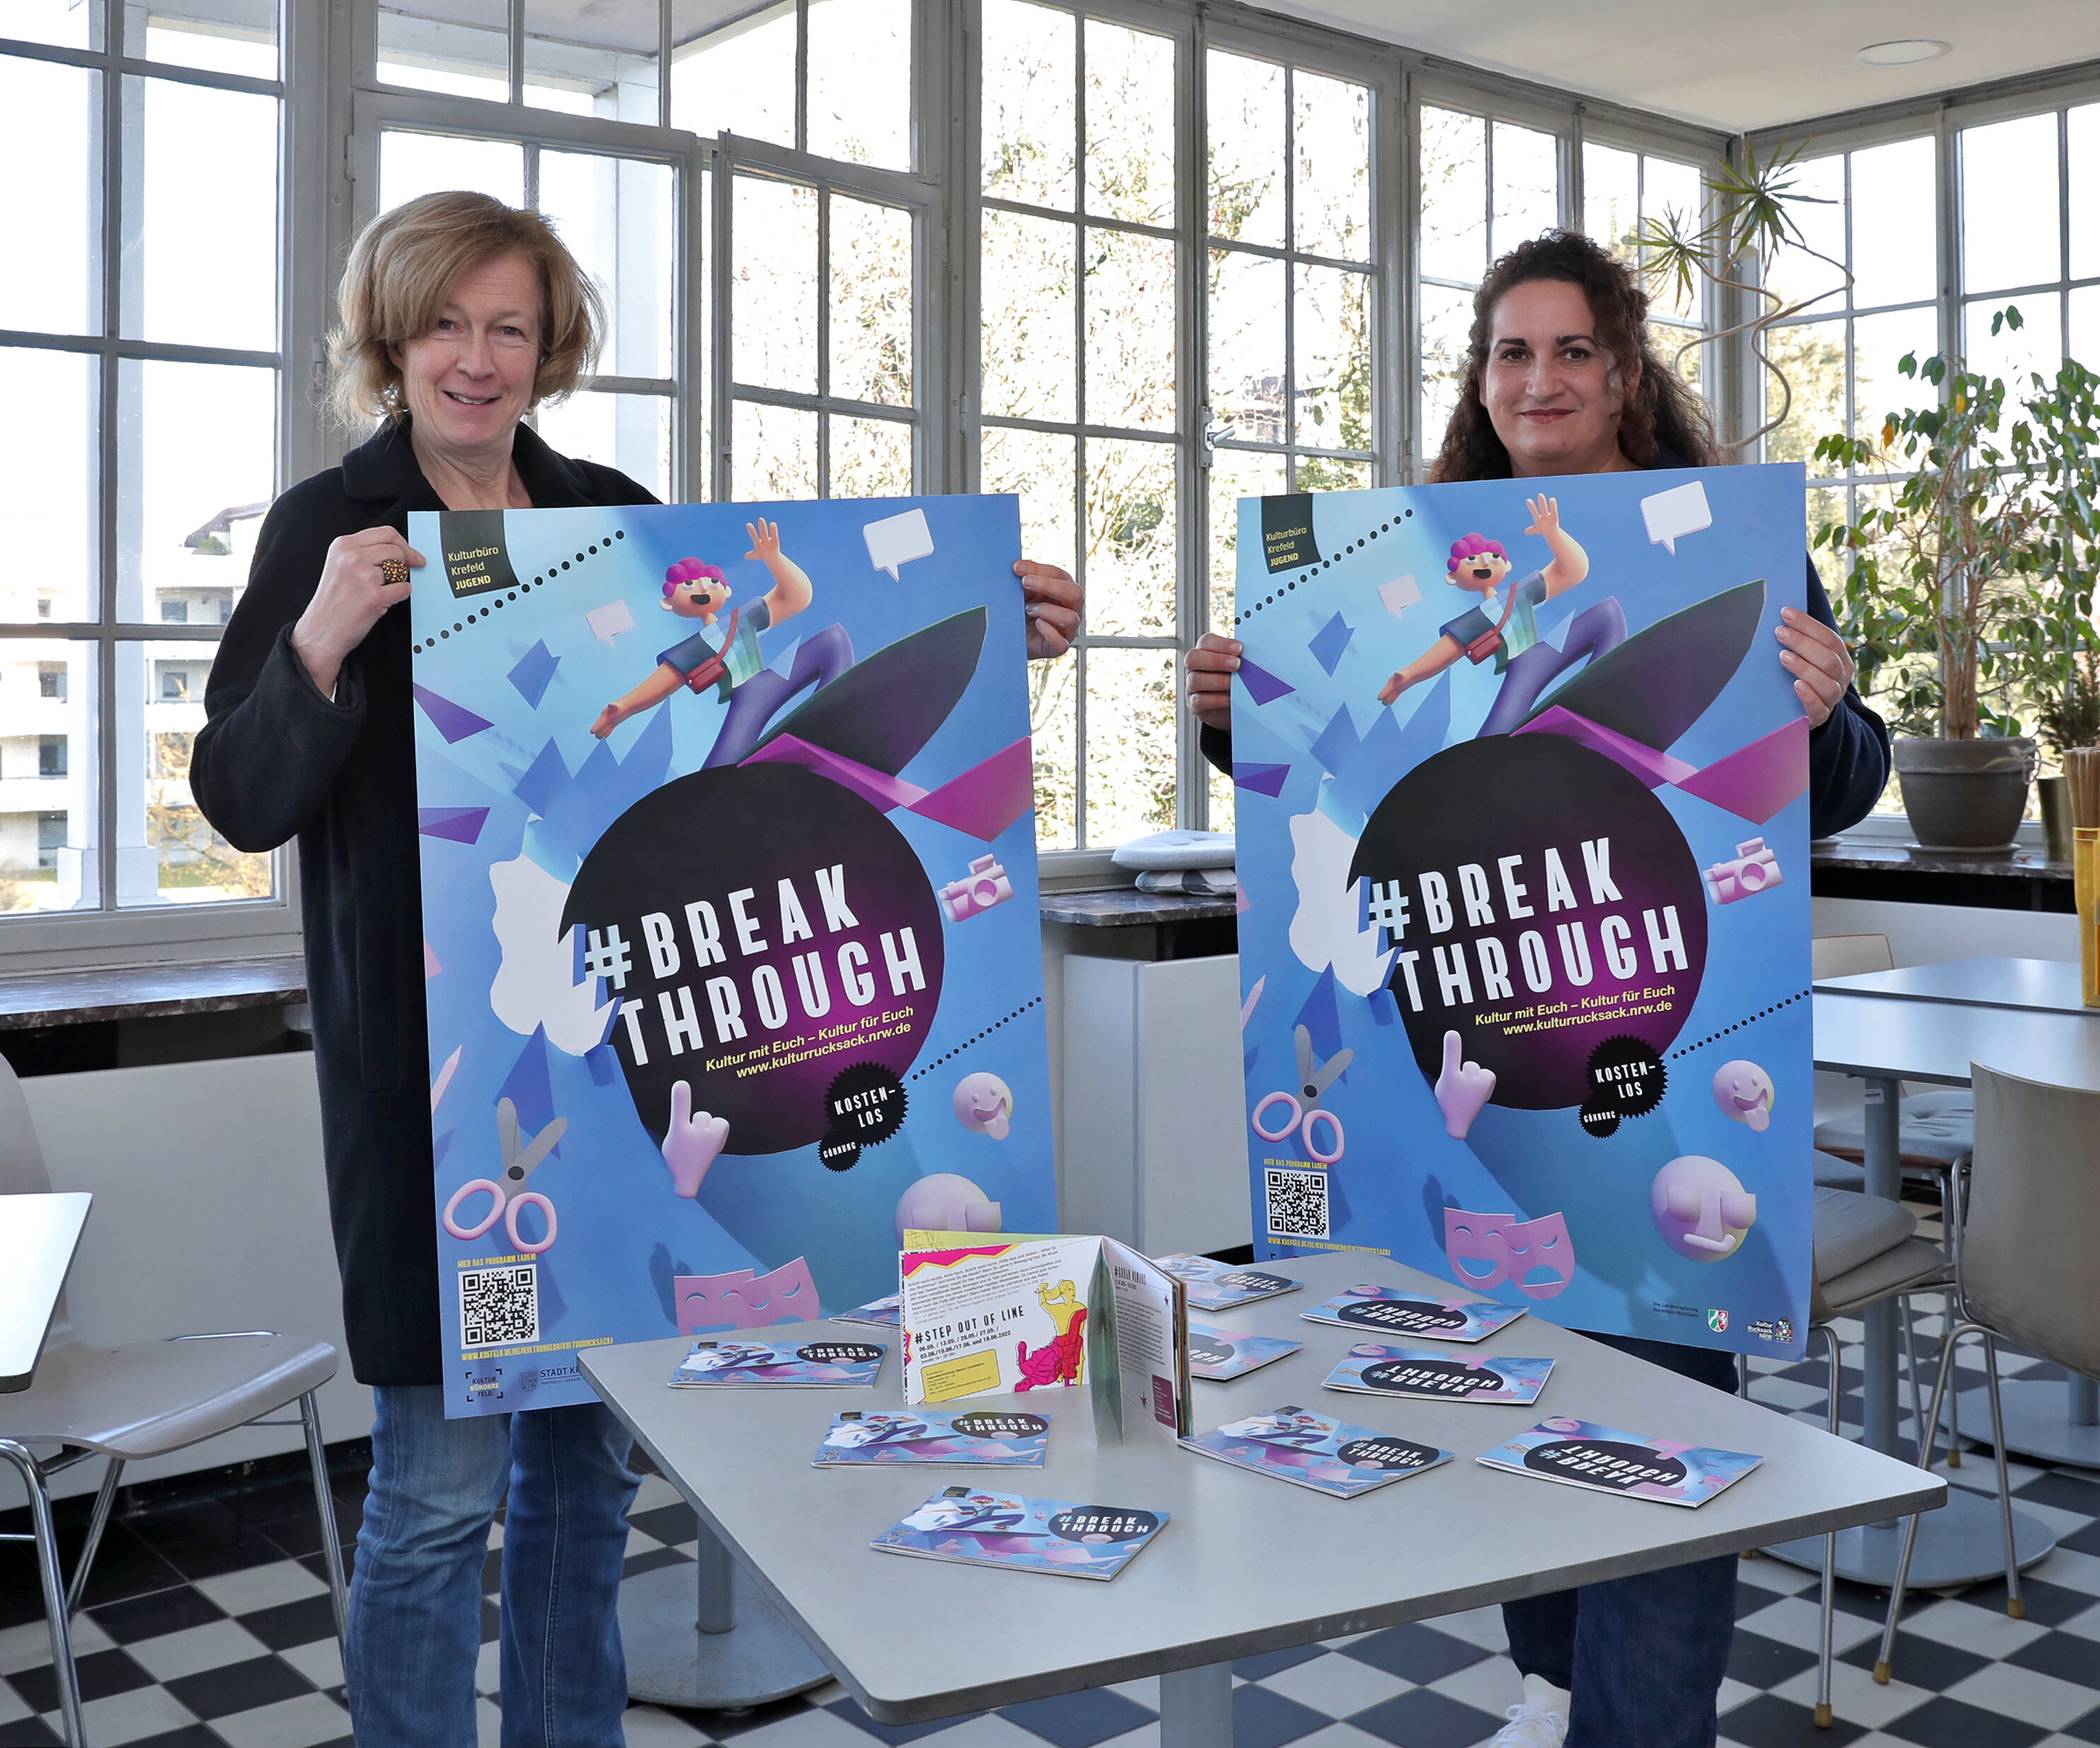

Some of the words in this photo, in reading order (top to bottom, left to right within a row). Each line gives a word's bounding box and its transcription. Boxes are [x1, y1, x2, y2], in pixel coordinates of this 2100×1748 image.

[1265, 527, 1307, 542] Kulturbüro
[447, 546, 499, 562] Kulturbüro
[1267, 541, 1295, 554] Krefeld
[451, 561, 485, 576] Krefeld
[1270, 552, 1299, 567] JUGEND
[455, 575, 491, 591] JUGEND
[1369, 837, 1623, 940] #BREAK
[585, 864, 859, 989] #BREAK
[1396, 905, 1688, 1012] THROUGH
[618, 926, 926, 1066] THROUGH
[1475, 1010, 1512, 1026] Kultur
[1514, 1005, 1535, 1020] mit
[1537, 1000, 1568, 1018] Euch
[1581, 993, 1620, 1010] Kultur
[1622, 990, 1641, 1004] für
[1643, 984, 1676, 1001] Euch
[1503, 999, 1673, 1036] www.kulturrucksack.nrw.de
[706, 1050, 747, 1072] Kultur
[749, 1043, 770, 1060] mit
[773, 1034, 805, 1055] Euch
[819, 1022, 857, 1042] Kultur
[860, 1015, 879, 1031] für
[882, 1005, 914, 1024] Euch
[736, 1022, 912, 1078] www.kulturrucksack.nrw.de
[1594, 1061, 1656, 1084] KOSTEN-
[1617, 1081, 1643, 1099] LOS
[834, 1086, 896, 1116] KOSTEN-
[857, 1108, 884, 1128] LOS
[915, 1325, 952, 1344] #STEP
[957, 1318, 977, 1333] OUT
[983, 1313, 995, 1326] OF
[1001, 1305, 1024, 1321] LINE
[472, 1376, 497, 1384] KULTUR
[540, 1366, 567, 1378] STADT
[1348, 1448, 1424, 1467] THROUGH
[1058, 1514, 1137, 1525] #BREAK
[1061, 1522, 1148, 1533] THROUGH
